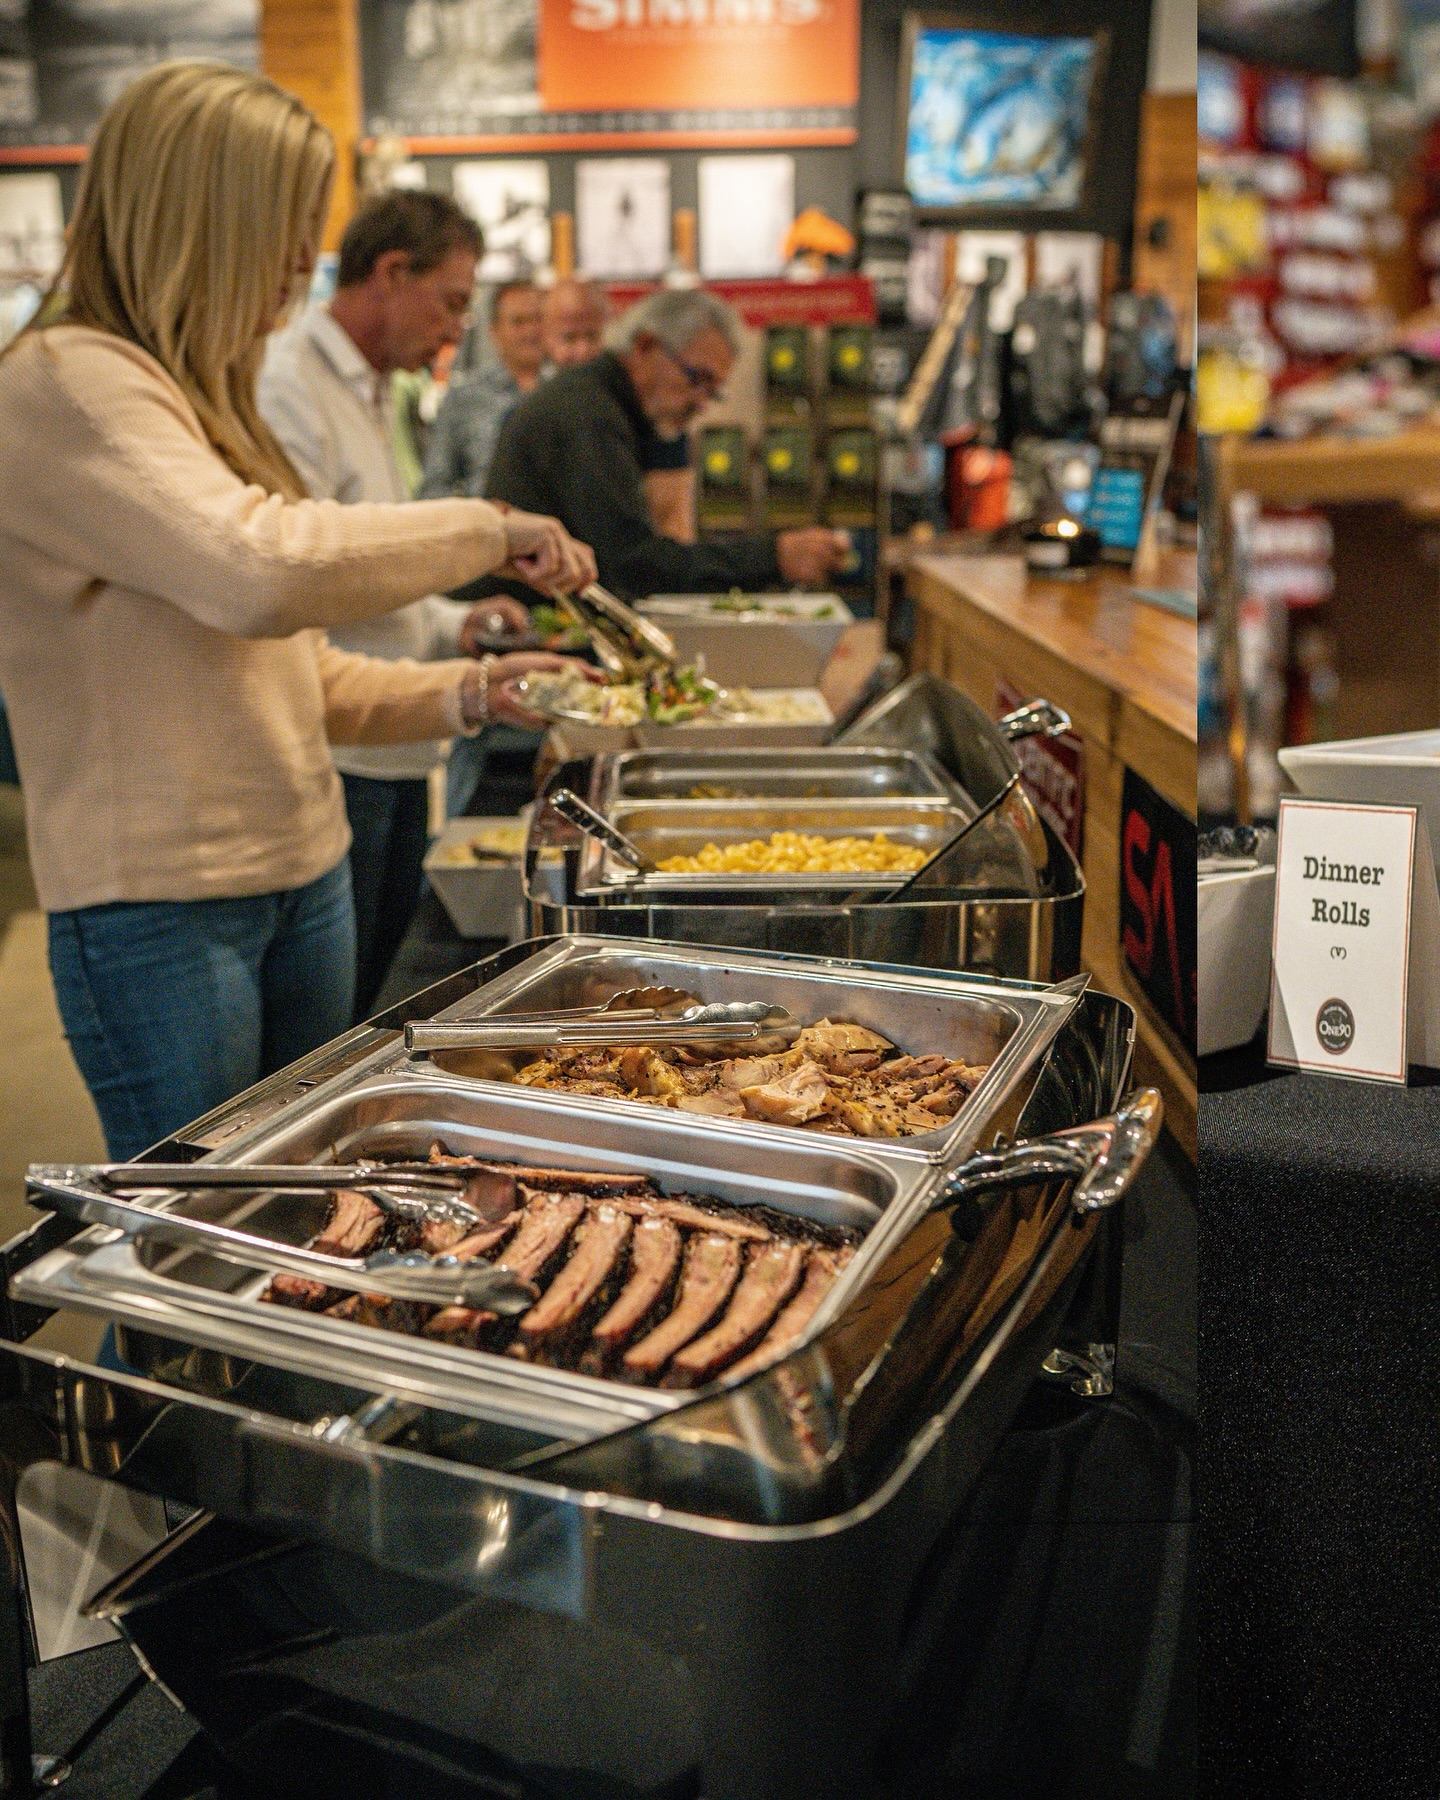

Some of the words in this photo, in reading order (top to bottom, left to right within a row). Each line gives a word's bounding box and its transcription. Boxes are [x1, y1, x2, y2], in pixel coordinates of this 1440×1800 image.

[1303, 856, 1384, 885] Dinner
[1311, 898, 1370, 927] Rolls
[1330, 946, 1347, 960] (V)
